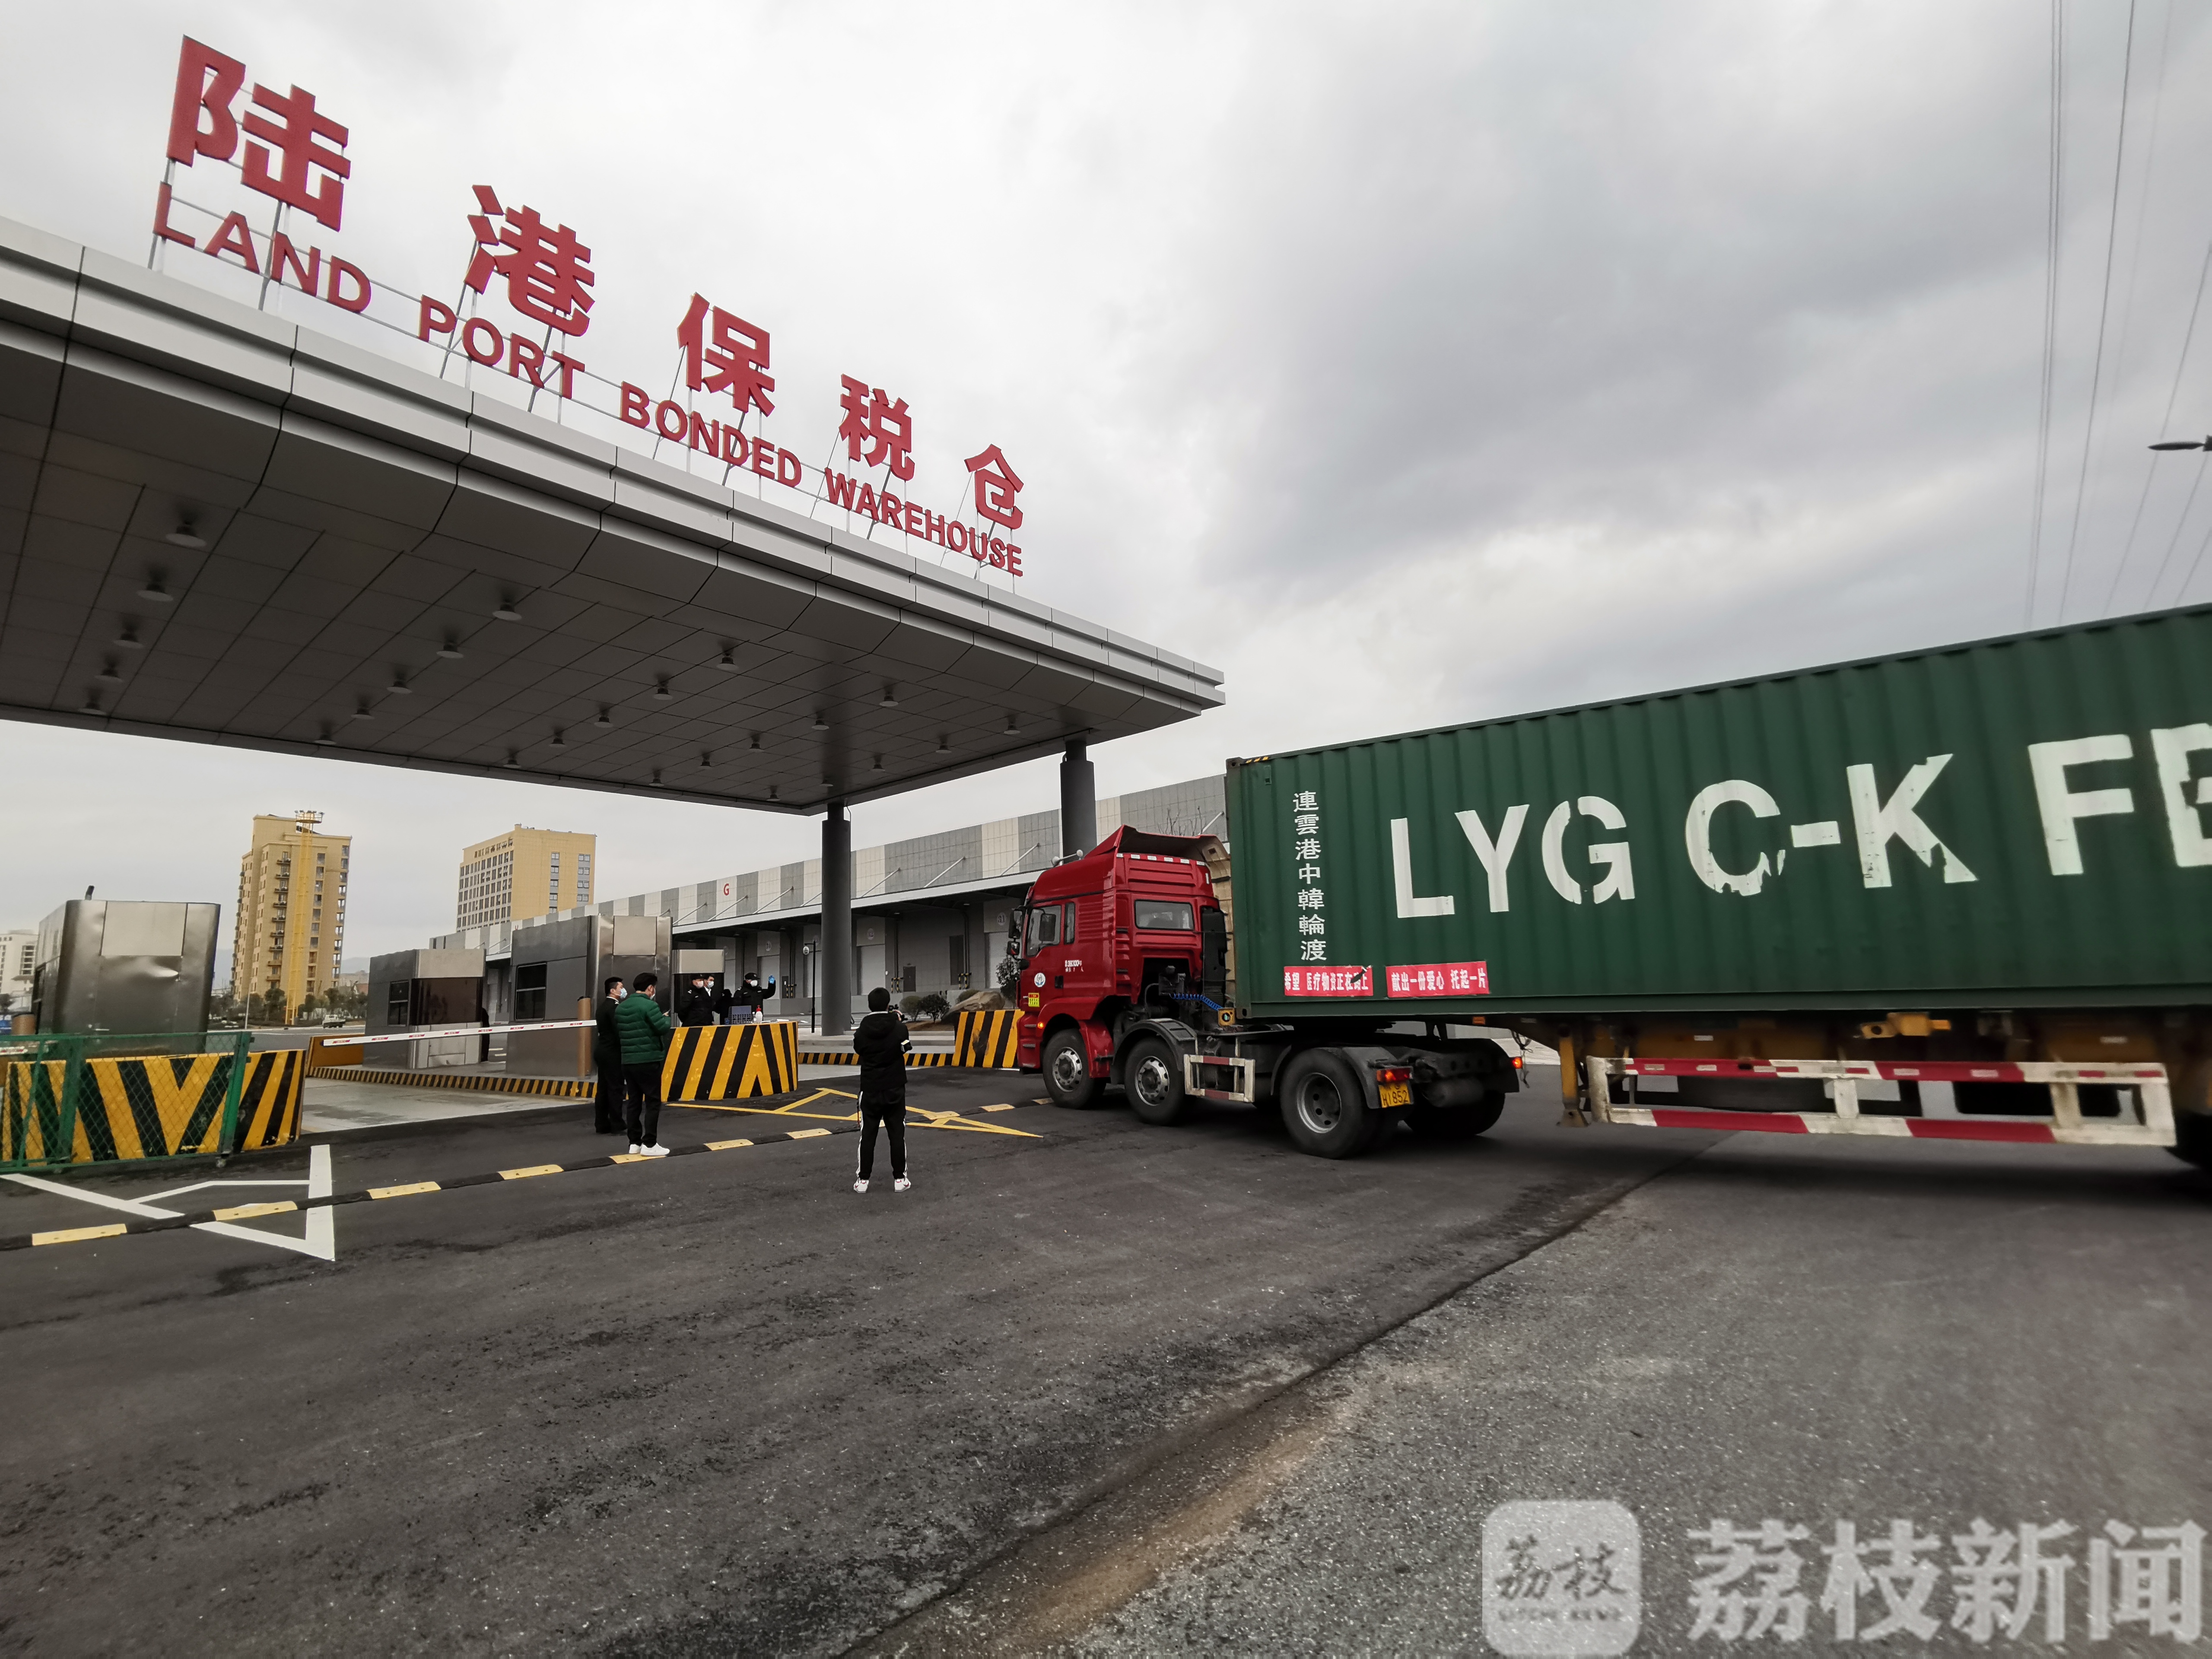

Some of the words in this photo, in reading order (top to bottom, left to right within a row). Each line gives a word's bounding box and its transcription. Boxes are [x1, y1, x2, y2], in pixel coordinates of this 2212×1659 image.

[167, 35, 1024, 530] 陆港保税仓
[153, 181, 371, 314] LAND
[418, 294, 585, 400] PORT
[620, 381, 802, 488] BONDED
[824, 467, 1023, 577] WAREHOUSE
[723, 883, 729, 896] G
[1293, 791, 1327, 961] 連雲港中韓輪渡
[1390, 796, 1636, 919] LYG
[1685, 779, 1978, 897] C-K
